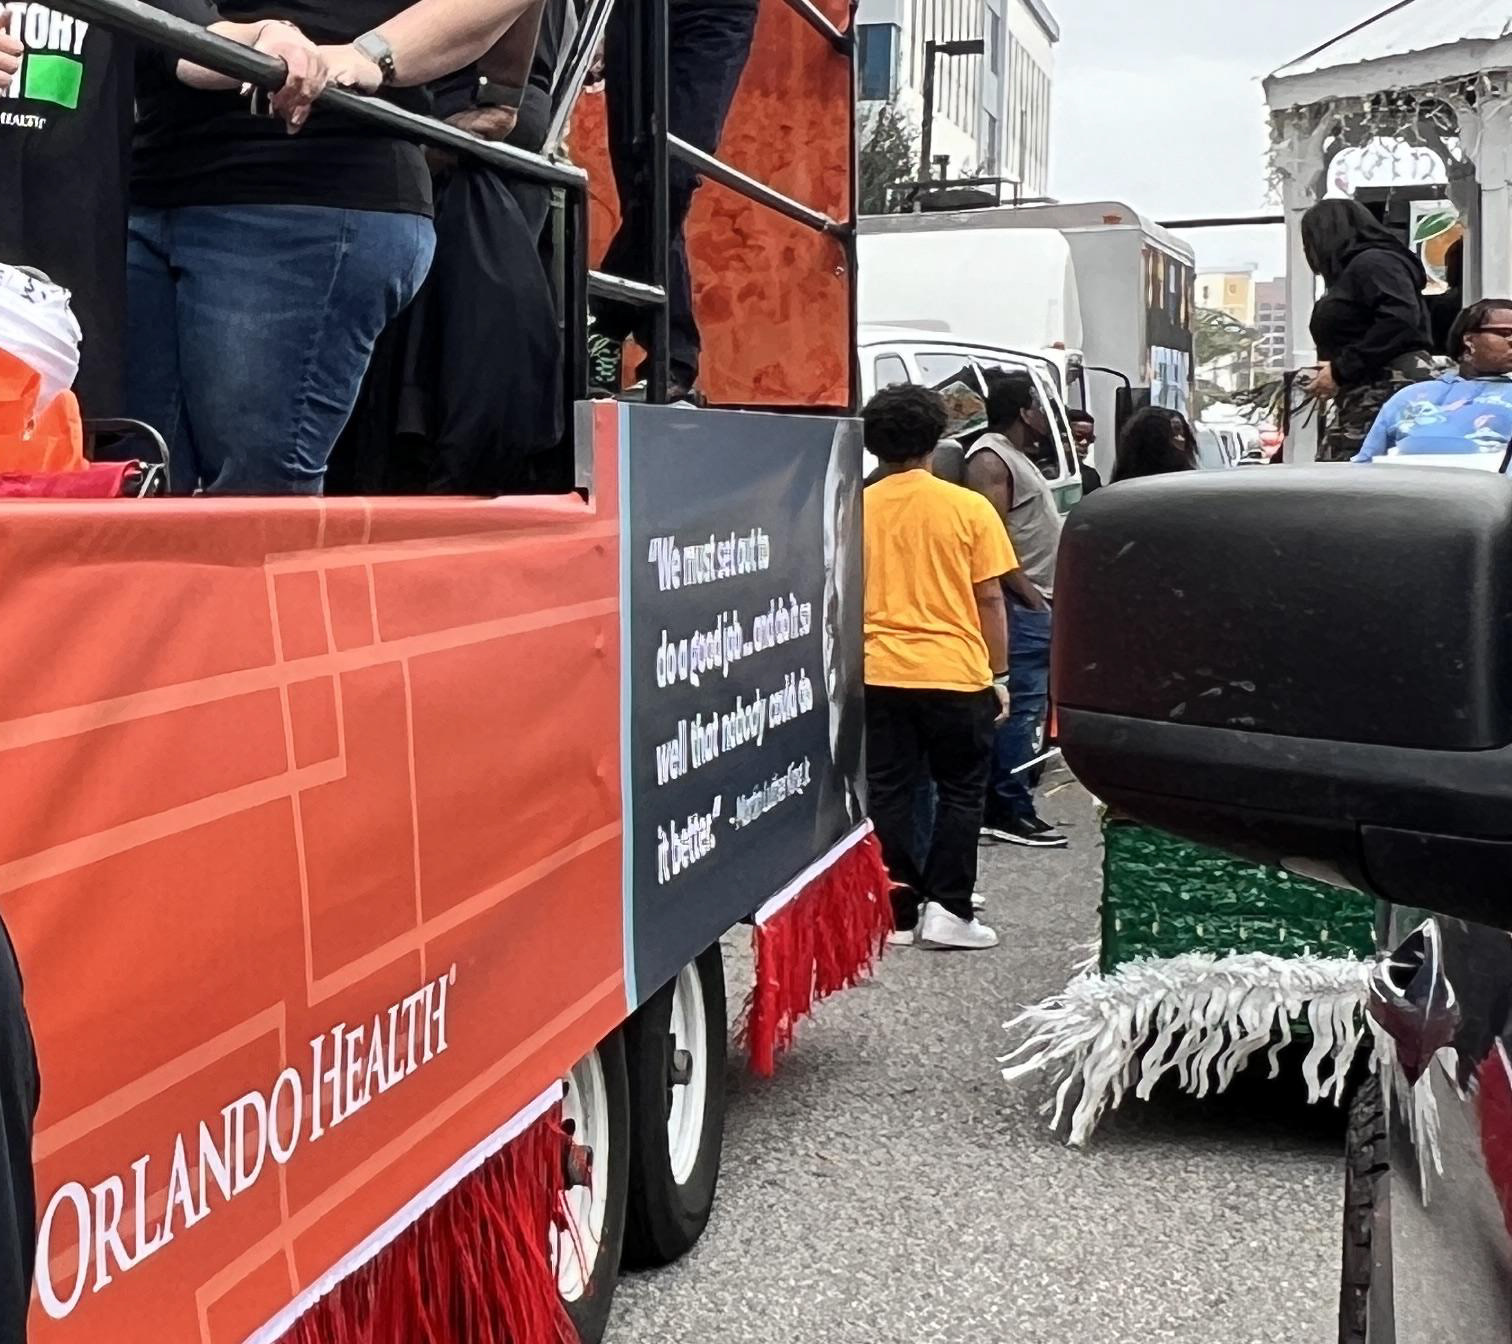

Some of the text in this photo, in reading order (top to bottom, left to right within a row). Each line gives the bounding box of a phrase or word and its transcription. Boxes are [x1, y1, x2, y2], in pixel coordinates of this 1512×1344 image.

[656, 719, 688, 786] well
[691, 712, 719, 769] that
[721, 688, 767, 752] nobody
[34, 1067, 303, 1320] ORLANDO
